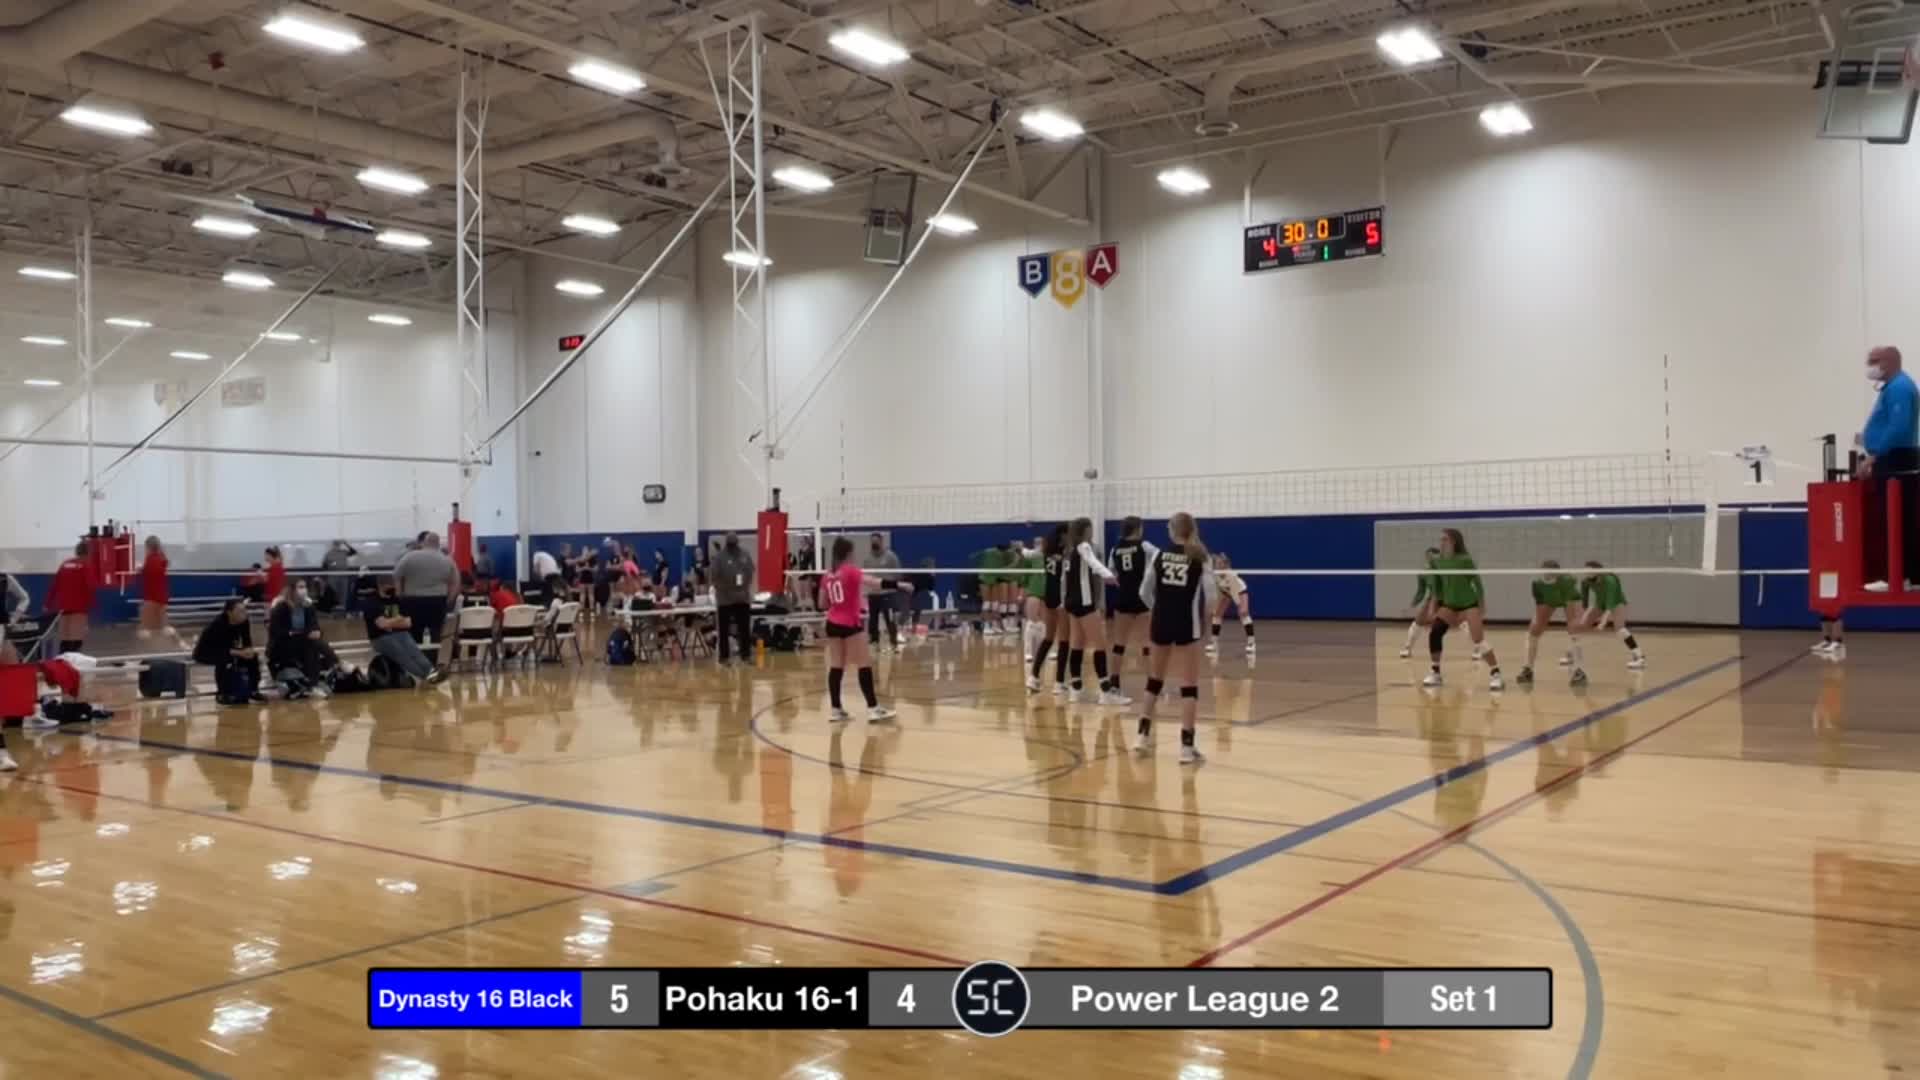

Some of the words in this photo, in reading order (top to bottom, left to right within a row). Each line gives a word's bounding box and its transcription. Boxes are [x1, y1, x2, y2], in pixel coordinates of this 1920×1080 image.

[1366, 222, 1379, 245] 5
[1263, 238, 1275, 257] 4
[1025, 260, 1042, 285] B
[1055, 256, 1080, 297] 8
[1091, 249, 1113, 276] A
[1750, 460, 1762, 483] 1
[1122, 554, 1133, 571] 8
[1162, 561, 1189, 587] 33
[827, 580, 845, 603] 10
